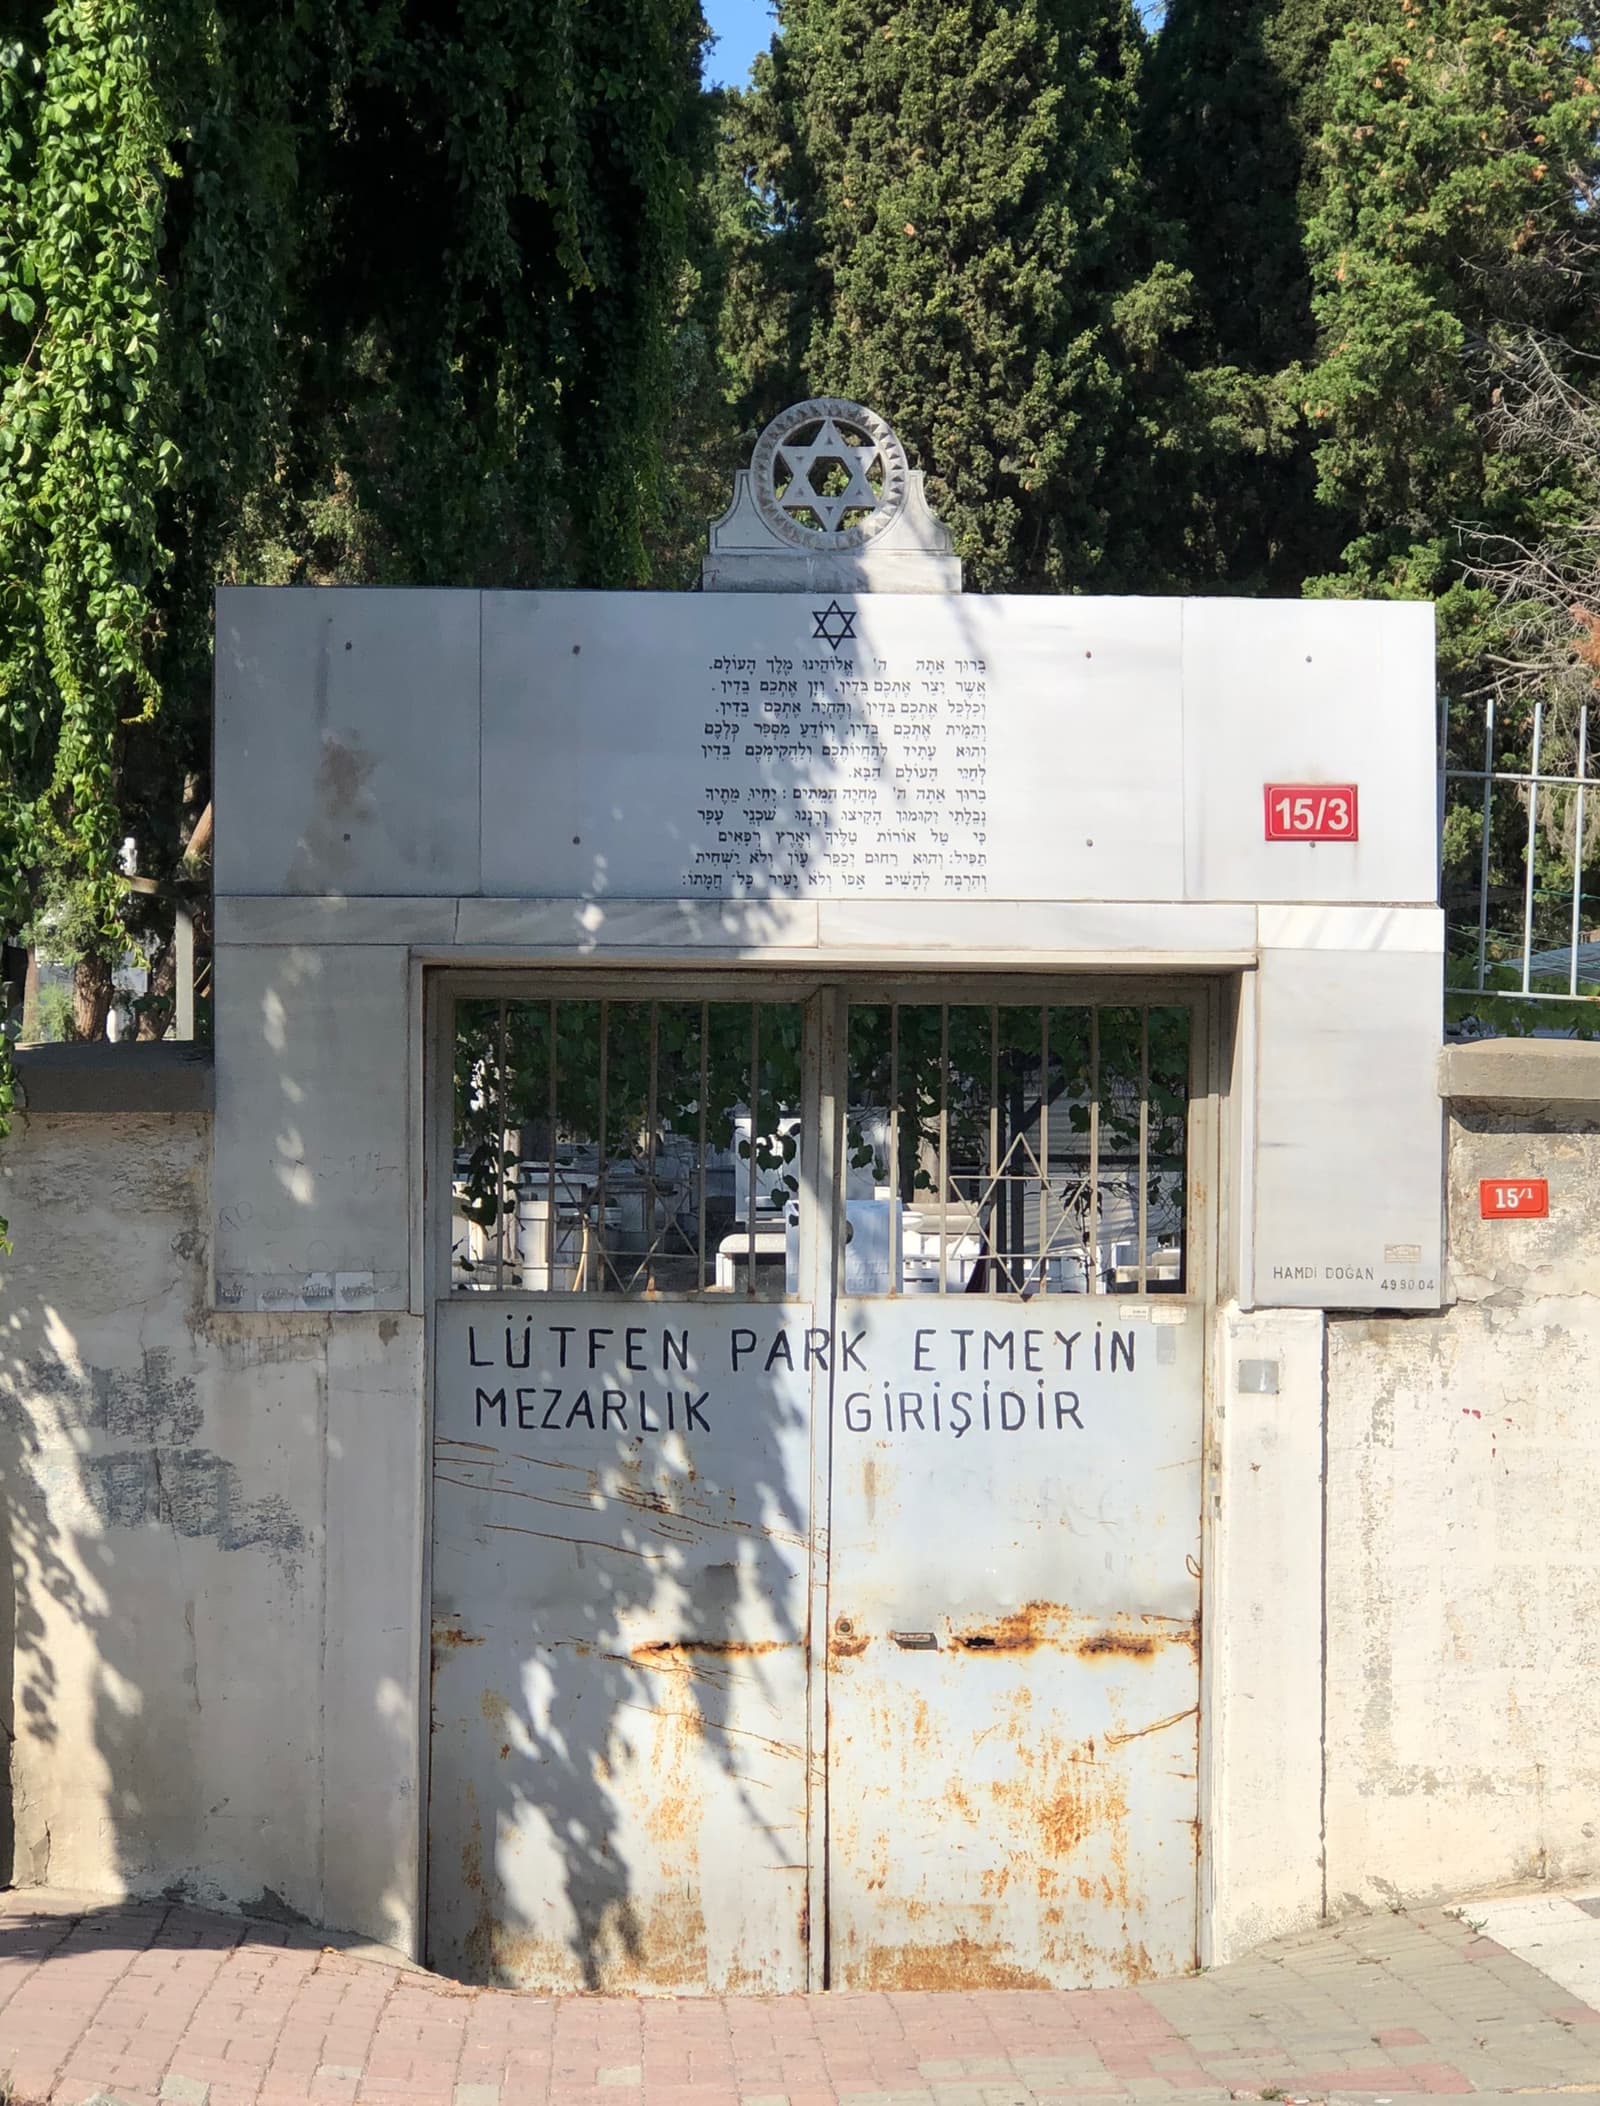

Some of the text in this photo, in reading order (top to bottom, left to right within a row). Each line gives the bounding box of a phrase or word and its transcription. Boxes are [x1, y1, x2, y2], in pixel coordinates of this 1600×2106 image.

[1275, 797, 1349, 831] 15/3
[1495, 1187, 1533, 1209] 15/1
[1325, 1264, 1375, 1281] DOĞAN
[468, 1315, 1136, 1374] LÜTFEN PARK ETMEYİN
[475, 1379, 1085, 1439] MEZARLIK GİRİŞİDİR
